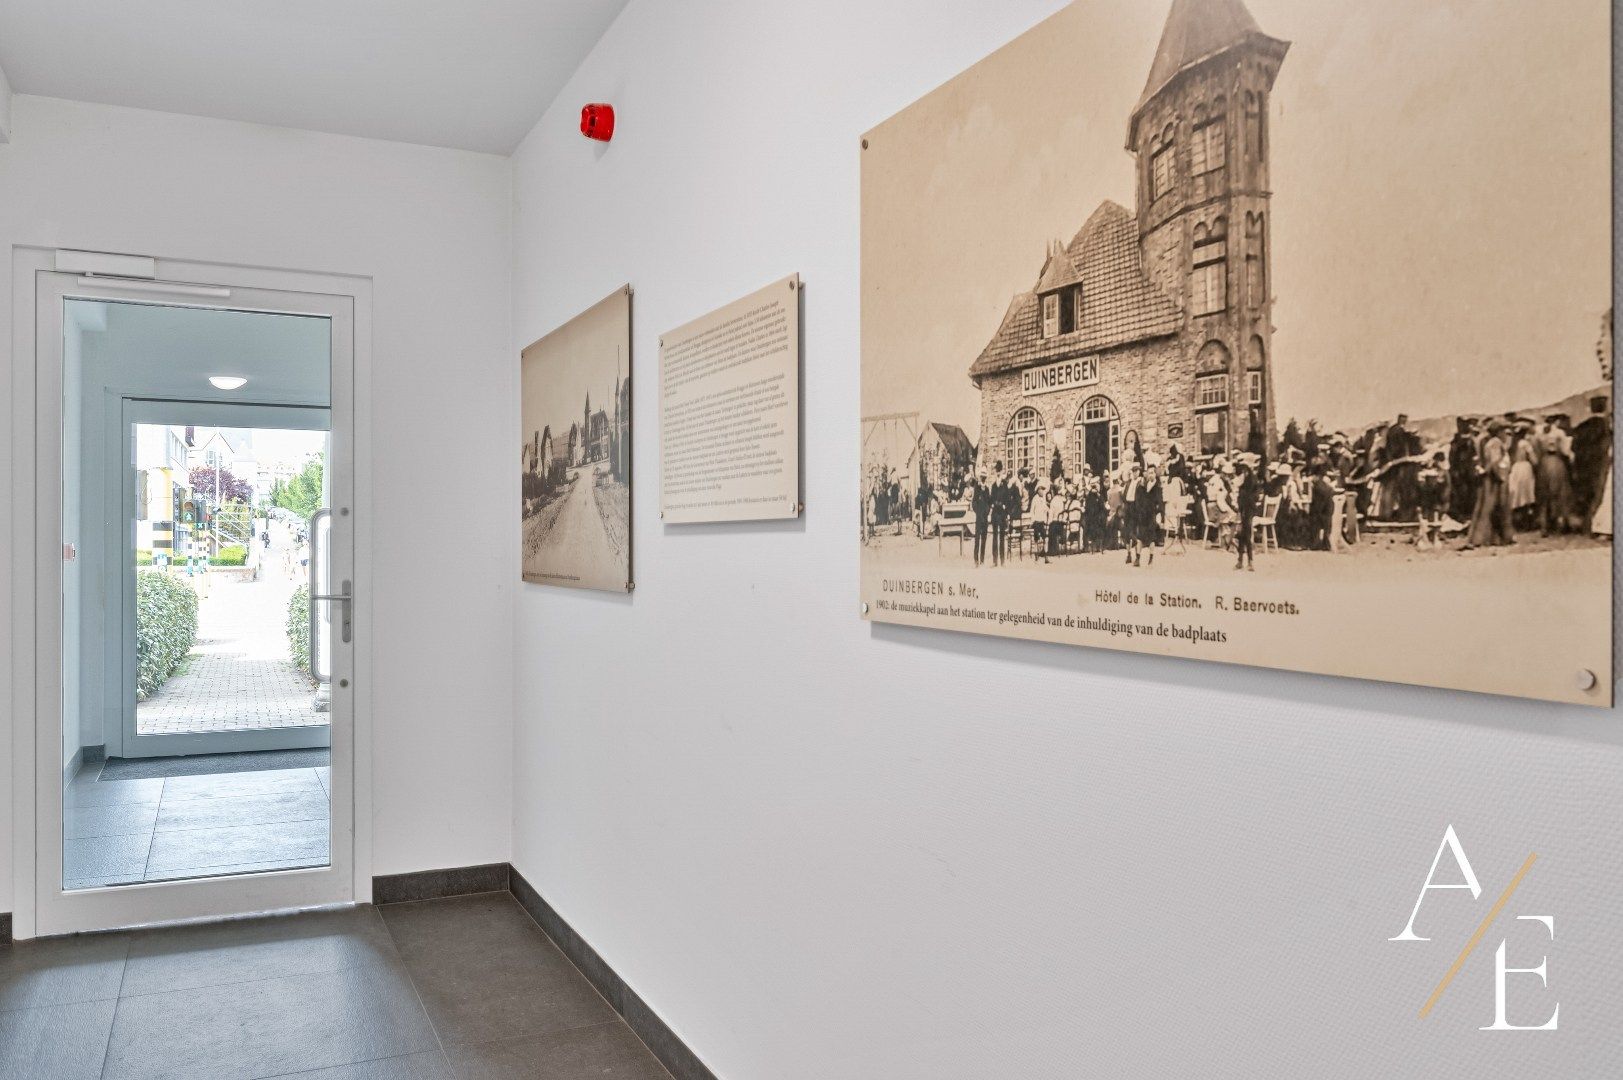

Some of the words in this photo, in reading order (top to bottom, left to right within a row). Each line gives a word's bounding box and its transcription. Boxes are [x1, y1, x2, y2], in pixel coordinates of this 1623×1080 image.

[1024, 359, 1097, 391] DUINBERGEN
[883, 579, 943, 595] DUINBERGEN
[949, 586, 955, 597] s.
[1095, 590, 1121, 604] Hôtel
[1127, 592, 1139, 604] de
[1145, 593, 1154, 605] la
[1160, 593, 1202, 609] Station.
[1215, 595, 1228, 611] R.
[891, 600, 898, 611] de
[899, 602, 936, 616] muziekkapel
[937, 607, 949, 616] aan
[950, 605, 961, 617] het
[962, 607, 986, 619] station
[987, 610, 998, 620] ter
[999, 610, 1045, 625] gelegenheid
[1047, 617, 1062, 627] van
[1064, 615, 1075, 628] de
[1077, 617, 1133, 637] inhuldiging
[1135, 624, 1153, 635] van
[1156, 622, 1169, 637] de
[1172, 623, 1227, 644] badplaats
